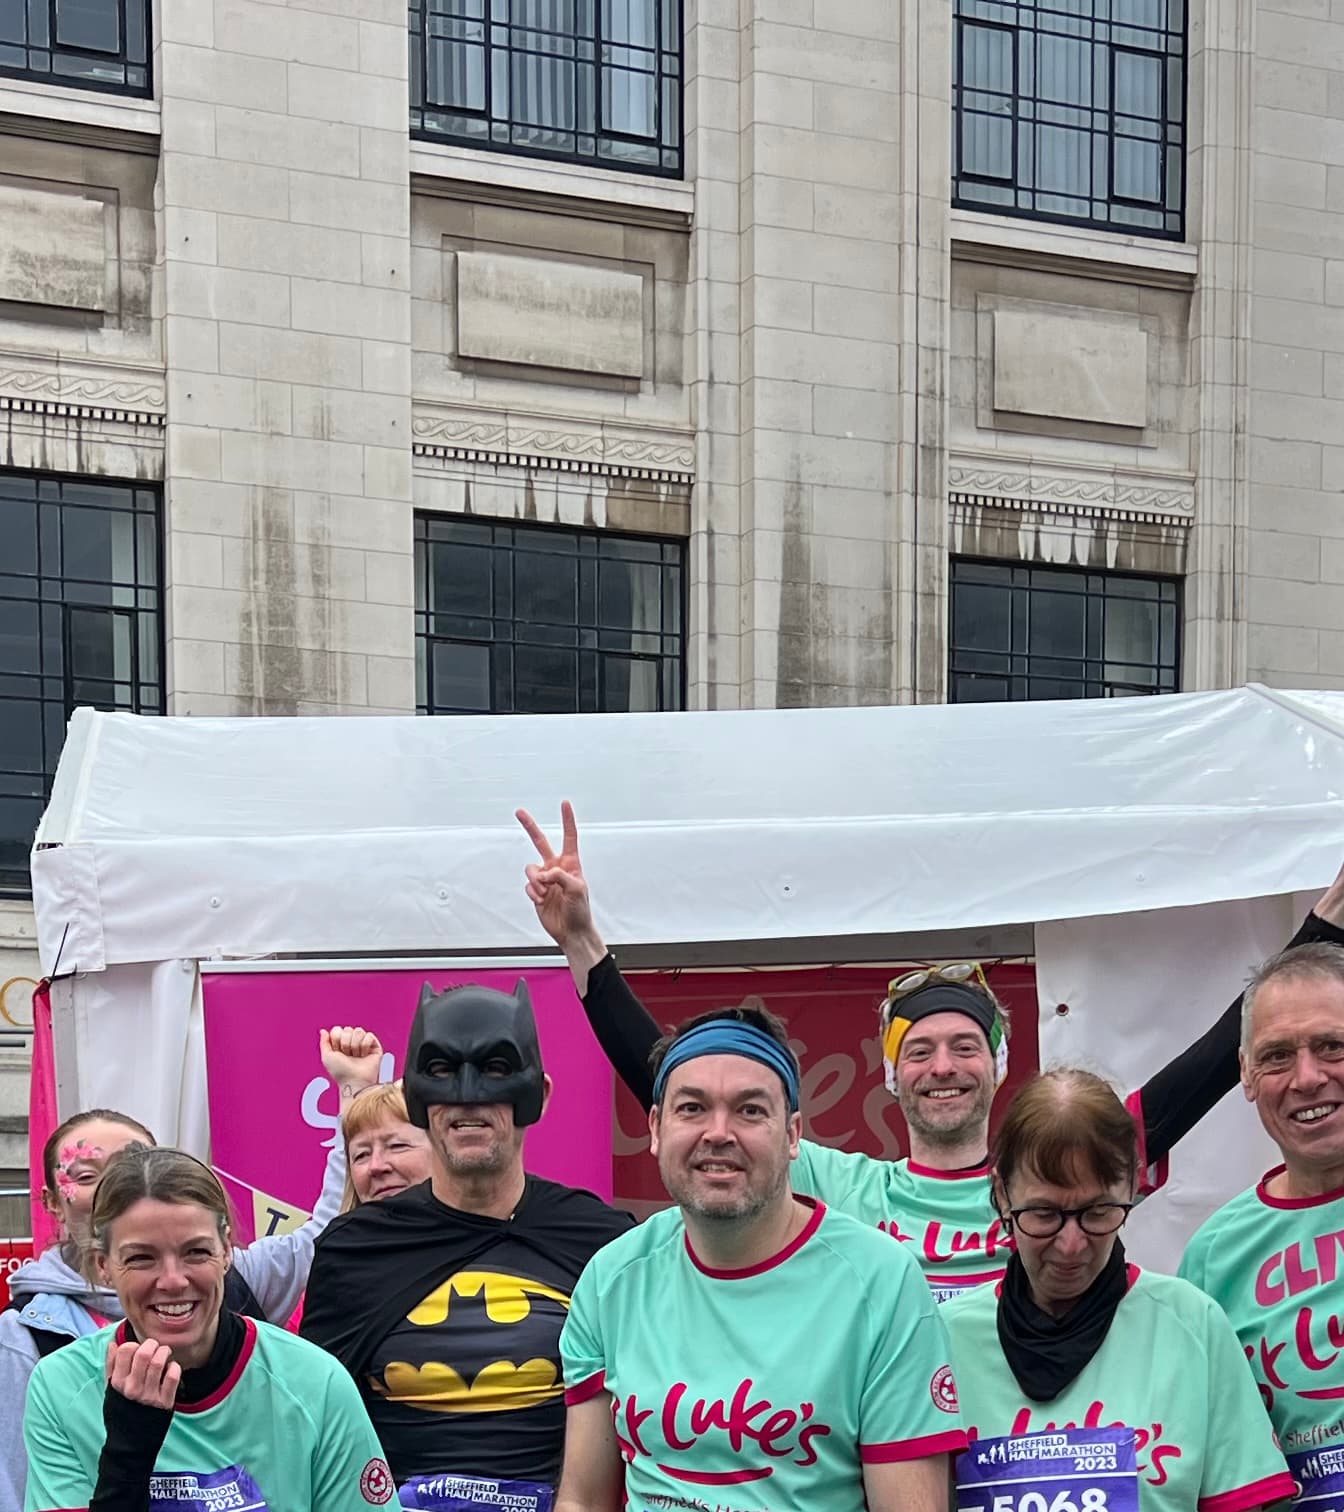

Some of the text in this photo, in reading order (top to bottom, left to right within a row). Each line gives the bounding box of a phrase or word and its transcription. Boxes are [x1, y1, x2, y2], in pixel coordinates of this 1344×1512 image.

[661, 1377, 832, 1467] Luke's
[1009, 1436, 1066, 1451] SHEFFIELD
[1009, 1444, 1116, 1461] HALF MARATHON
[1074, 1456, 1117, 1471] 2023
[150, 1482, 239, 1501] HALF MARATHON
[446, 1478, 497, 1494] SHEFFIELD
[473, 1489, 537, 1508] MARATHON
